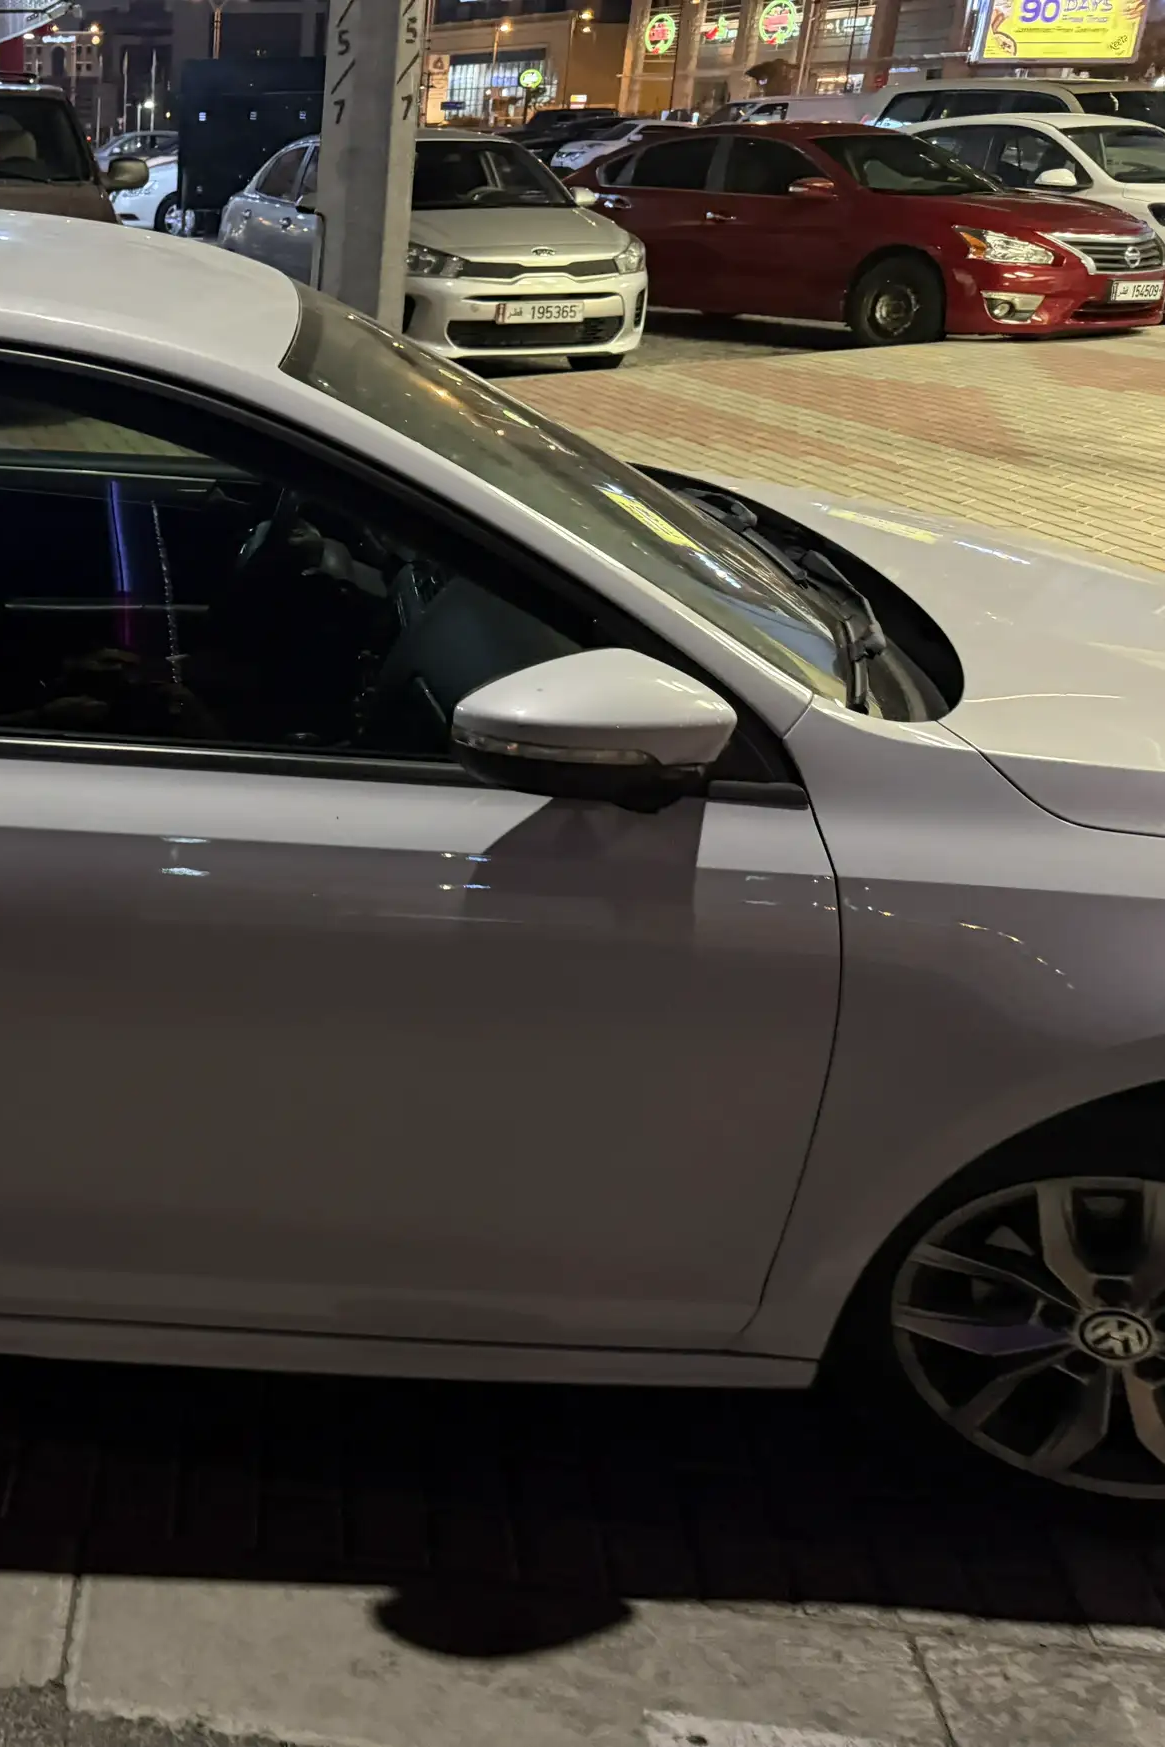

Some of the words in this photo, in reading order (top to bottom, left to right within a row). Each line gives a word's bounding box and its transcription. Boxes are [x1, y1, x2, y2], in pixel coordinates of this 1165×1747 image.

[1020, 0, 1061, 23] 90
[1131, 284, 1159, 298] 154509
[530, 304, 577, 320] 195365
